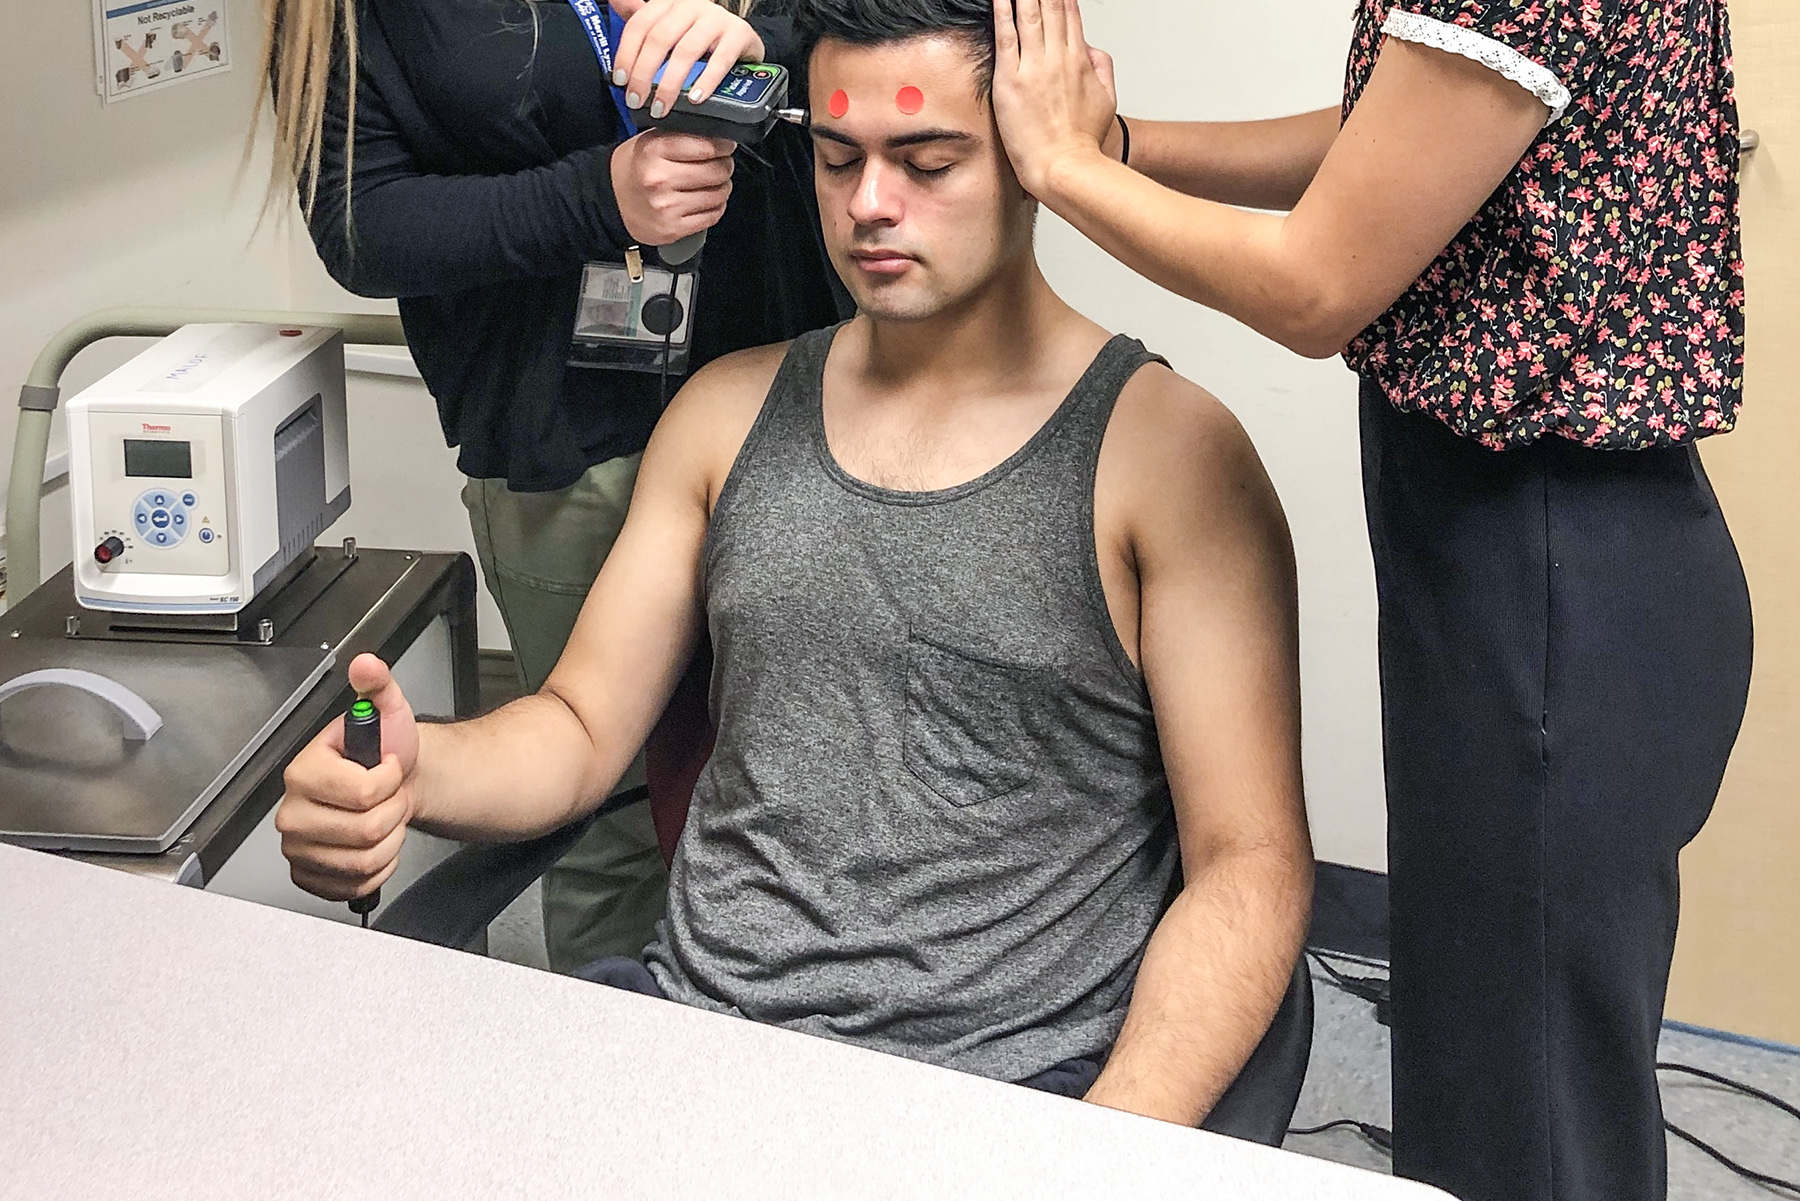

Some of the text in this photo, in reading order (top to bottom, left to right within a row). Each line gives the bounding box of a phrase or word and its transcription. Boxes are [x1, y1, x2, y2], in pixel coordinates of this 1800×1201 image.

[138, 5, 195, 25] Not Recyclable
[590, 14, 609, 48] Merrill
[142, 423, 171, 431] Thermo
